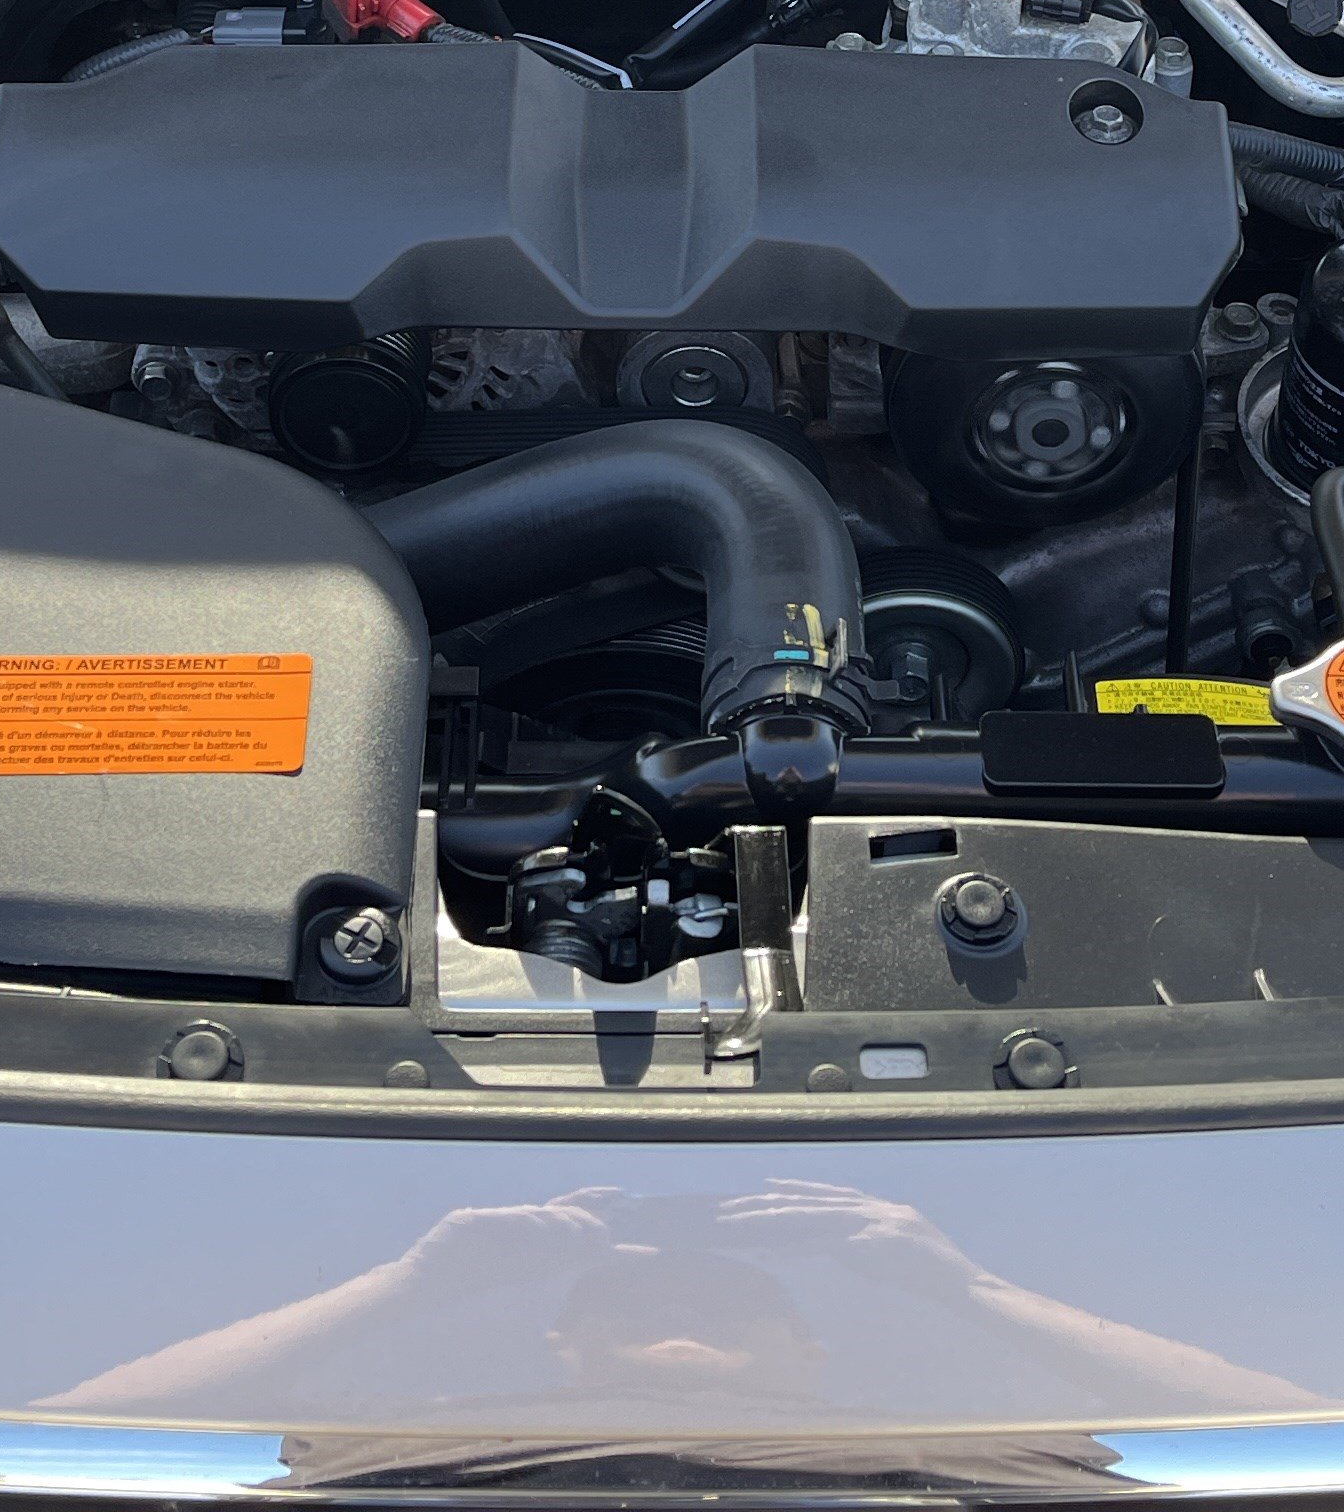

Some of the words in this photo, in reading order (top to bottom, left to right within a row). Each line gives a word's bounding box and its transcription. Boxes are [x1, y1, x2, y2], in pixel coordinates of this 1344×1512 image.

[1299, 438, 1336, 470] TOKYO
[76, 658, 228, 670] AVERTISSEMENT
[39, 680, 63, 690] with
[75, 681, 115, 690] remote
[117, 680, 175, 689] controlled
[177, 681, 215, 691] engine
[1150, 681, 1192, 691] CAUTION
[1198, 683, 1248, 696] ATTENTION
[1, 693, 14, 702] of
[16, 693, 57, 702] serious
[110, 692, 147, 702] Death,
[149, 691, 212, 700] disconnect
[214, 691, 233, 700] the
[235, 691, 276, 700] vehicle
[42, 706, 64, 715] any
[66, 704, 107, 713] service
[127, 704, 146, 713] the
[148, 703, 192, 712] vehicle.
[7, 730, 32, 739] d'un
[34, 729, 93, 739] démarreur
[106, 729, 158, 738] distance.
[161, 729, 189, 738] Pour
[191, 729, 233, 738] réduire
[235, 729, 252, 738] les
[8, 744, 47, 754] graves
[50, 744, 65, 752] ou
[127, 741, 191, 750] débrancher
[193, 741, 204, 750] la
[206, 741, 249, 750] batterie
[252, 741, 268, 750] du
[33, 755, 54, 765] des
[57, 754, 101, 764] travaux
[103, 753, 165, 763] d'entretien
[167, 755, 186, 763] sur
